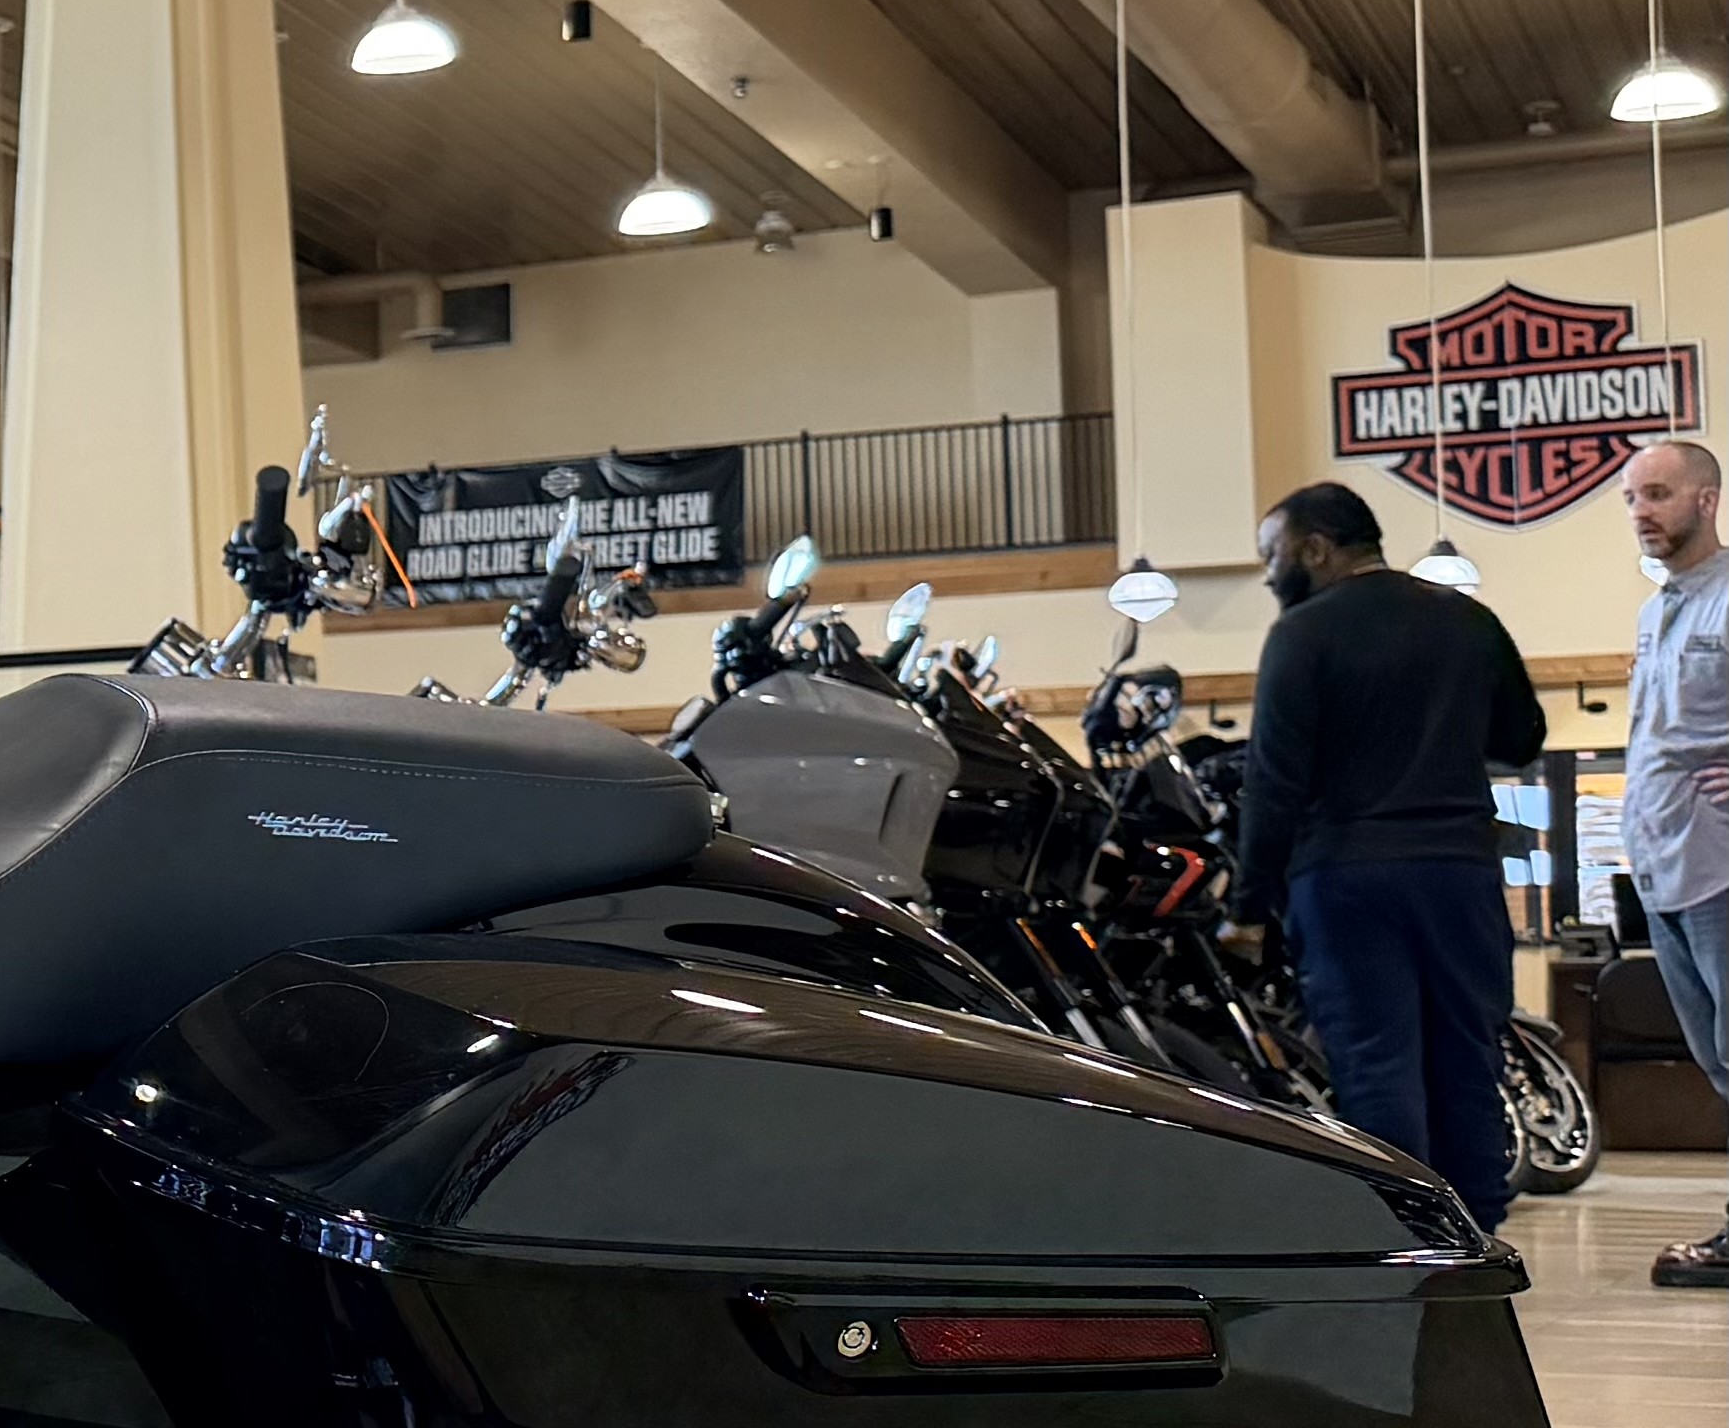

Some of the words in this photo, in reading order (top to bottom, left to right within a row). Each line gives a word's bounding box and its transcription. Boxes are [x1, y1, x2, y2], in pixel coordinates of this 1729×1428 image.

[1427, 305, 1597, 371] MOTOR
[1353, 364, 1676, 441] HARLEY-DAVIDSON
[1429, 435, 1602, 510] CYCLES
[576, 498, 609, 535] HE
[611, 490, 714, 532] ALL-NEW
[407, 543, 465, 582] ROAD
[466, 538, 532, 578] GLIDE
[652, 526, 721, 565] GLIDE
[247, 811, 369, 830] Harley
[262, 823, 400, 844] Davidson
